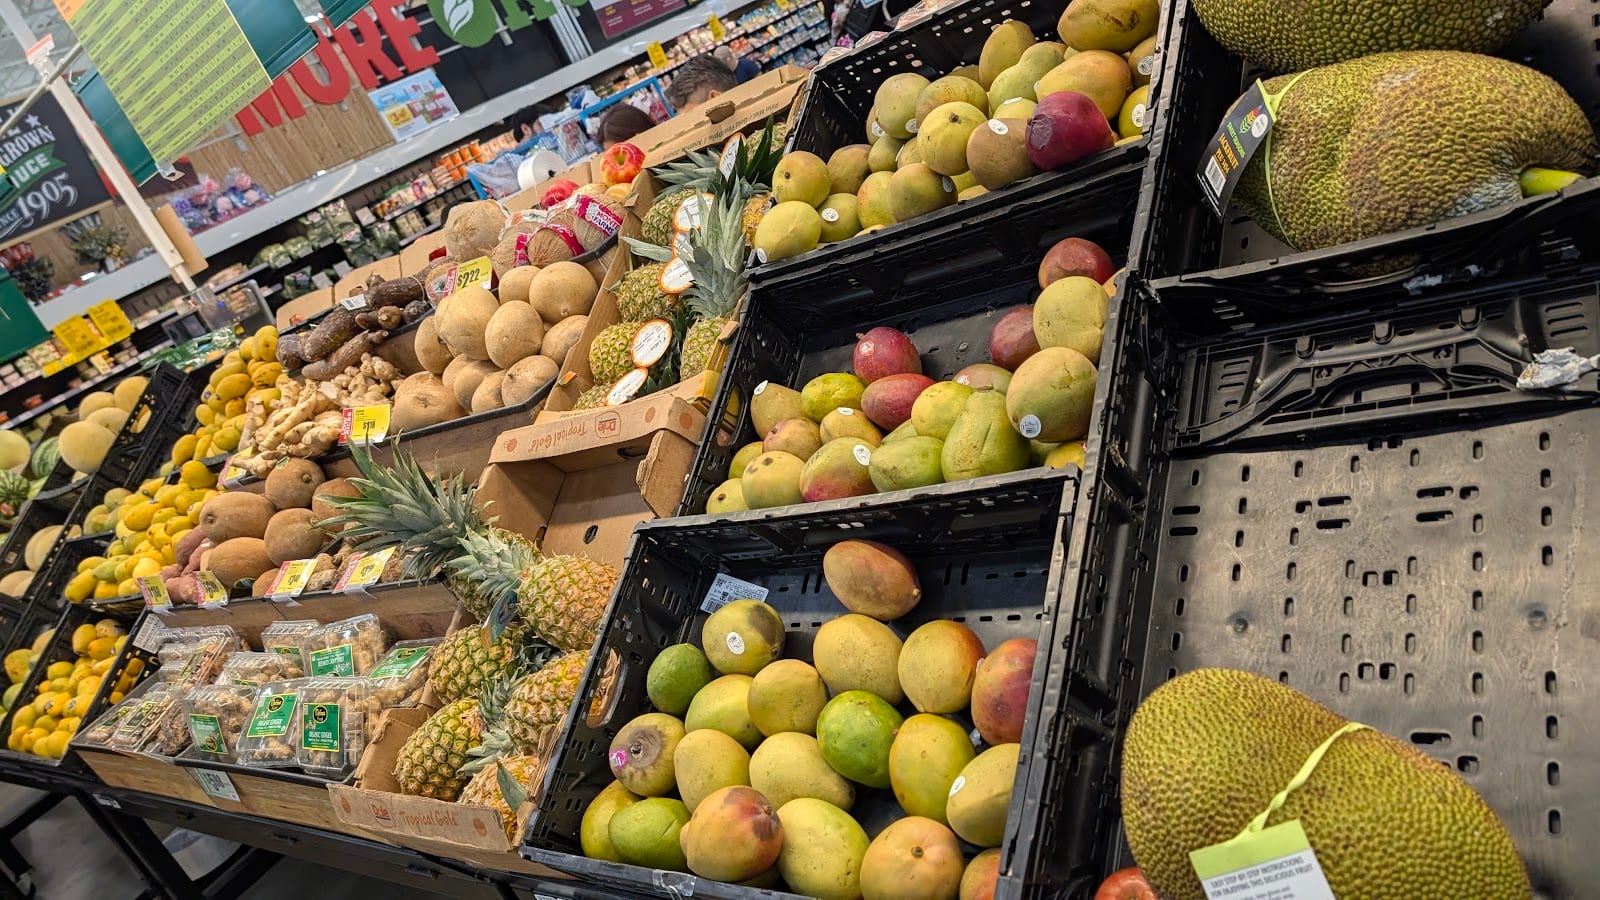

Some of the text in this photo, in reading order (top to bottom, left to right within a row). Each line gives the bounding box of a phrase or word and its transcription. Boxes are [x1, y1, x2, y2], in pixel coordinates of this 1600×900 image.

[1218, 132, 1239, 169] JACKFRUIT
[17, 170, 78, 222] 1905
[593, 217, 615, 234] FARMS
[597, 211, 621, 231] MONTE
[530, 419, 617, 452] Dole Tropical Gold
[371, 804, 389, 817] Dole
[399, 809, 436, 832] Tropical
[1211, 888, 1222, 898] FOR
[1222, 881, 1251, 896] ENJOYING
[1250, 877, 1264, 888] THIS
[1263, 869, 1296, 885] DELICIOUS
[1295, 863, 1313, 876] FRUIT
[1224, 875, 1238, 885] STEP
[1246, 868, 1260, 879] STEP
[1260, 855, 1305, 875] INSTRUCTIONS
